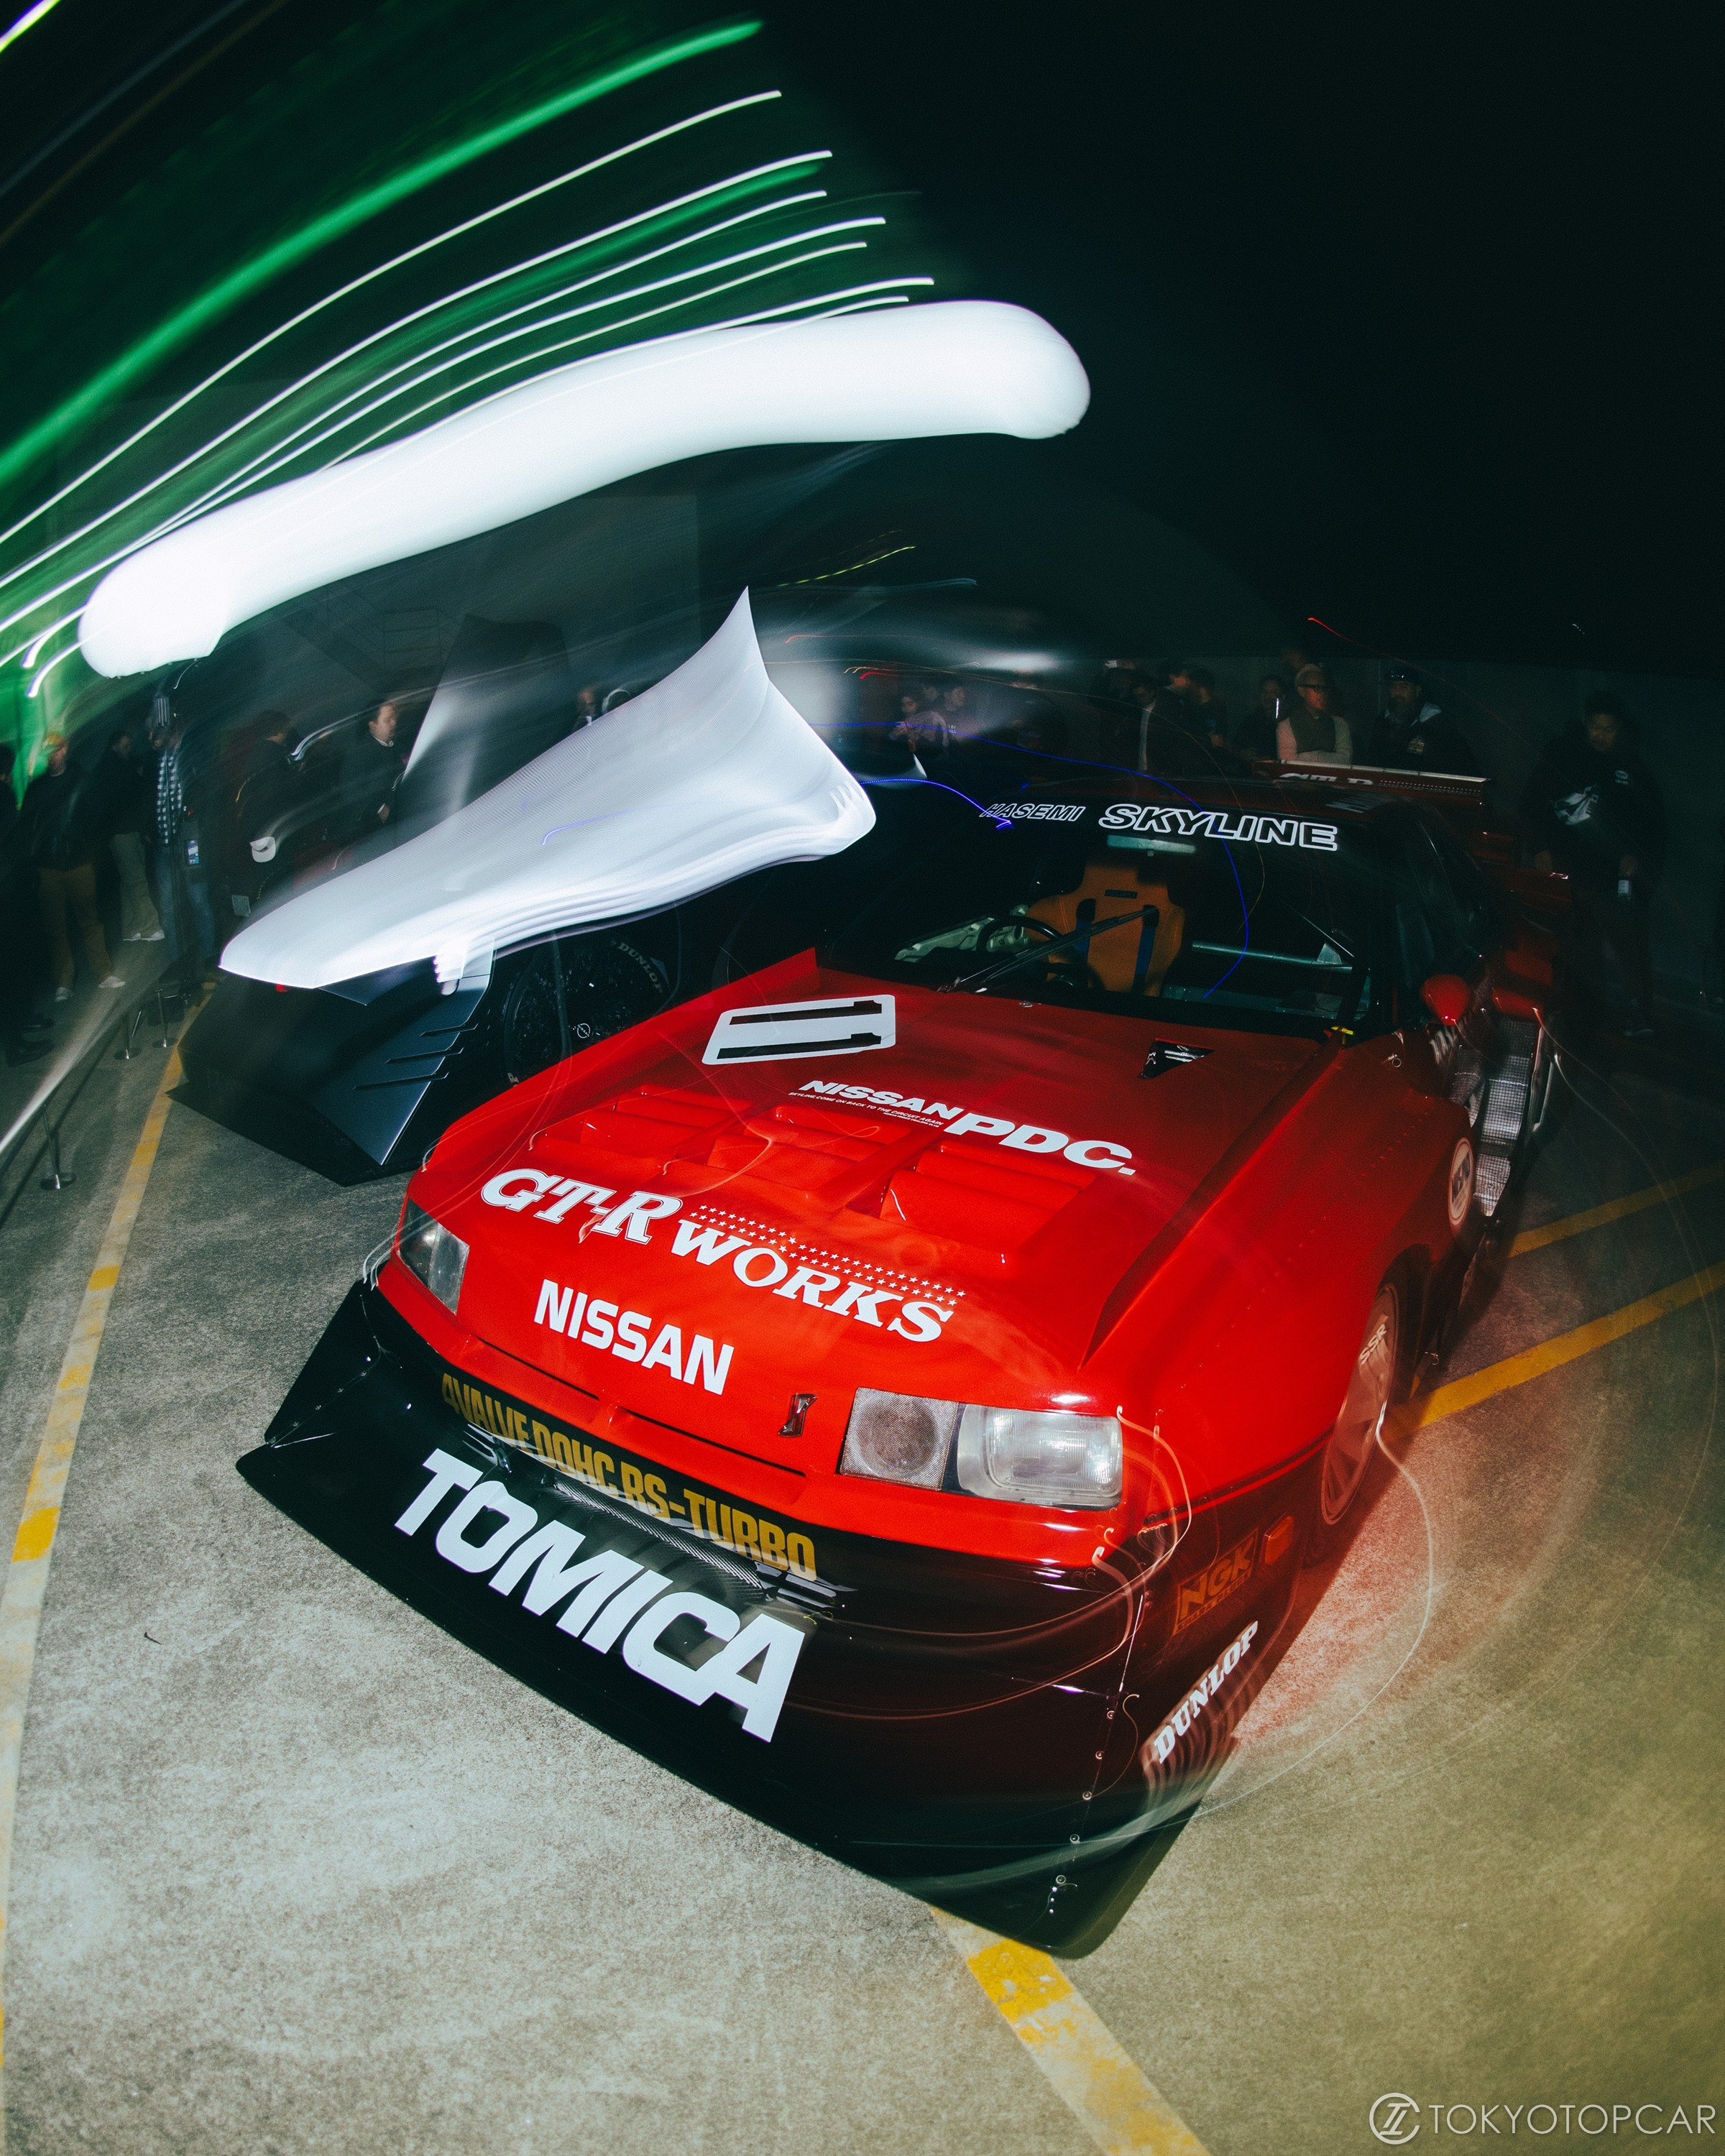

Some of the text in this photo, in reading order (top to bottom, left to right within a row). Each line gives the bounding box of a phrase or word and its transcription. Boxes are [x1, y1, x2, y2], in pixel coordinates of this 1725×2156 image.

[979, 803, 1086, 822] HASEMI
[1098, 803, 1338, 852] SKYLINE
[618, 942, 663, 993] DUNLOP
[799, 1079, 965, 1120] NISSAN
[891, 1110, 921, 1120] CIRCUIT
[919, 1116, 944, 1126] AGAIN
[480, 1168, 954, 1342] GT-R WORKS
[533, 1278, 735, 1396] NISSAN
[532, 1419, 620, 1498] DOHC
[620, 1460, 817, 1582] RS-TURBO
[394, 1447, 806, 1743] TOMICA
[1179, 1536, 1254, 1620] NGK
[1153, 1620, 1258, 1764] DUNLOP
